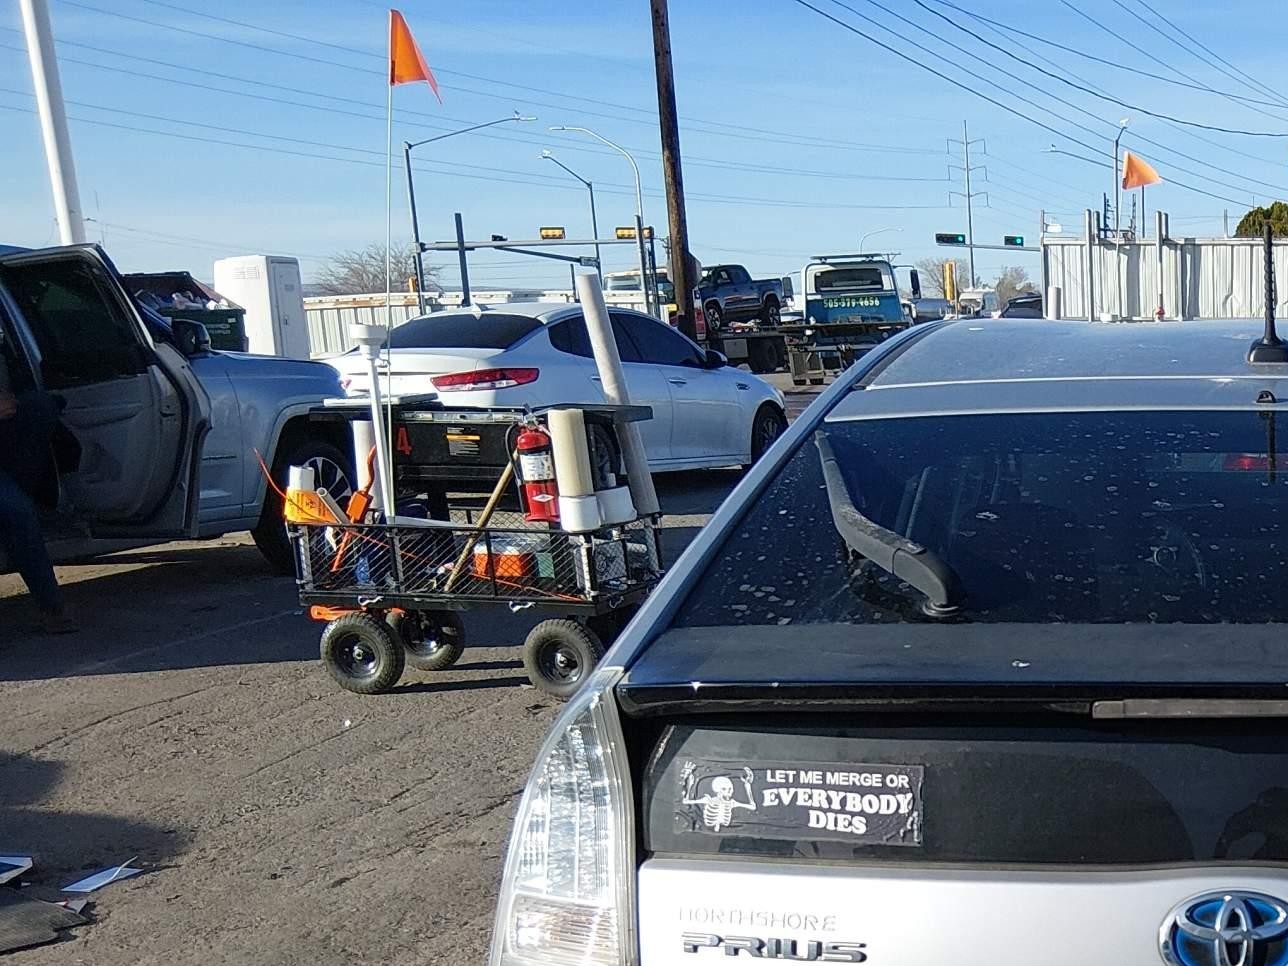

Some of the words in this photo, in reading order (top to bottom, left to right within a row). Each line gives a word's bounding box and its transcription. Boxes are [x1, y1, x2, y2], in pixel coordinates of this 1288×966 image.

[766, 769, 796, 784] LET
[800, 770, 823, 785] ME
[826, 771, 882, 787] MERGE
[886, 774, 909, 788] OR
[762, 787, 913, 815] EVERYBODY
[808, 809, 867, 834] DIES
[681, 932, 868, 964] PRIUS
